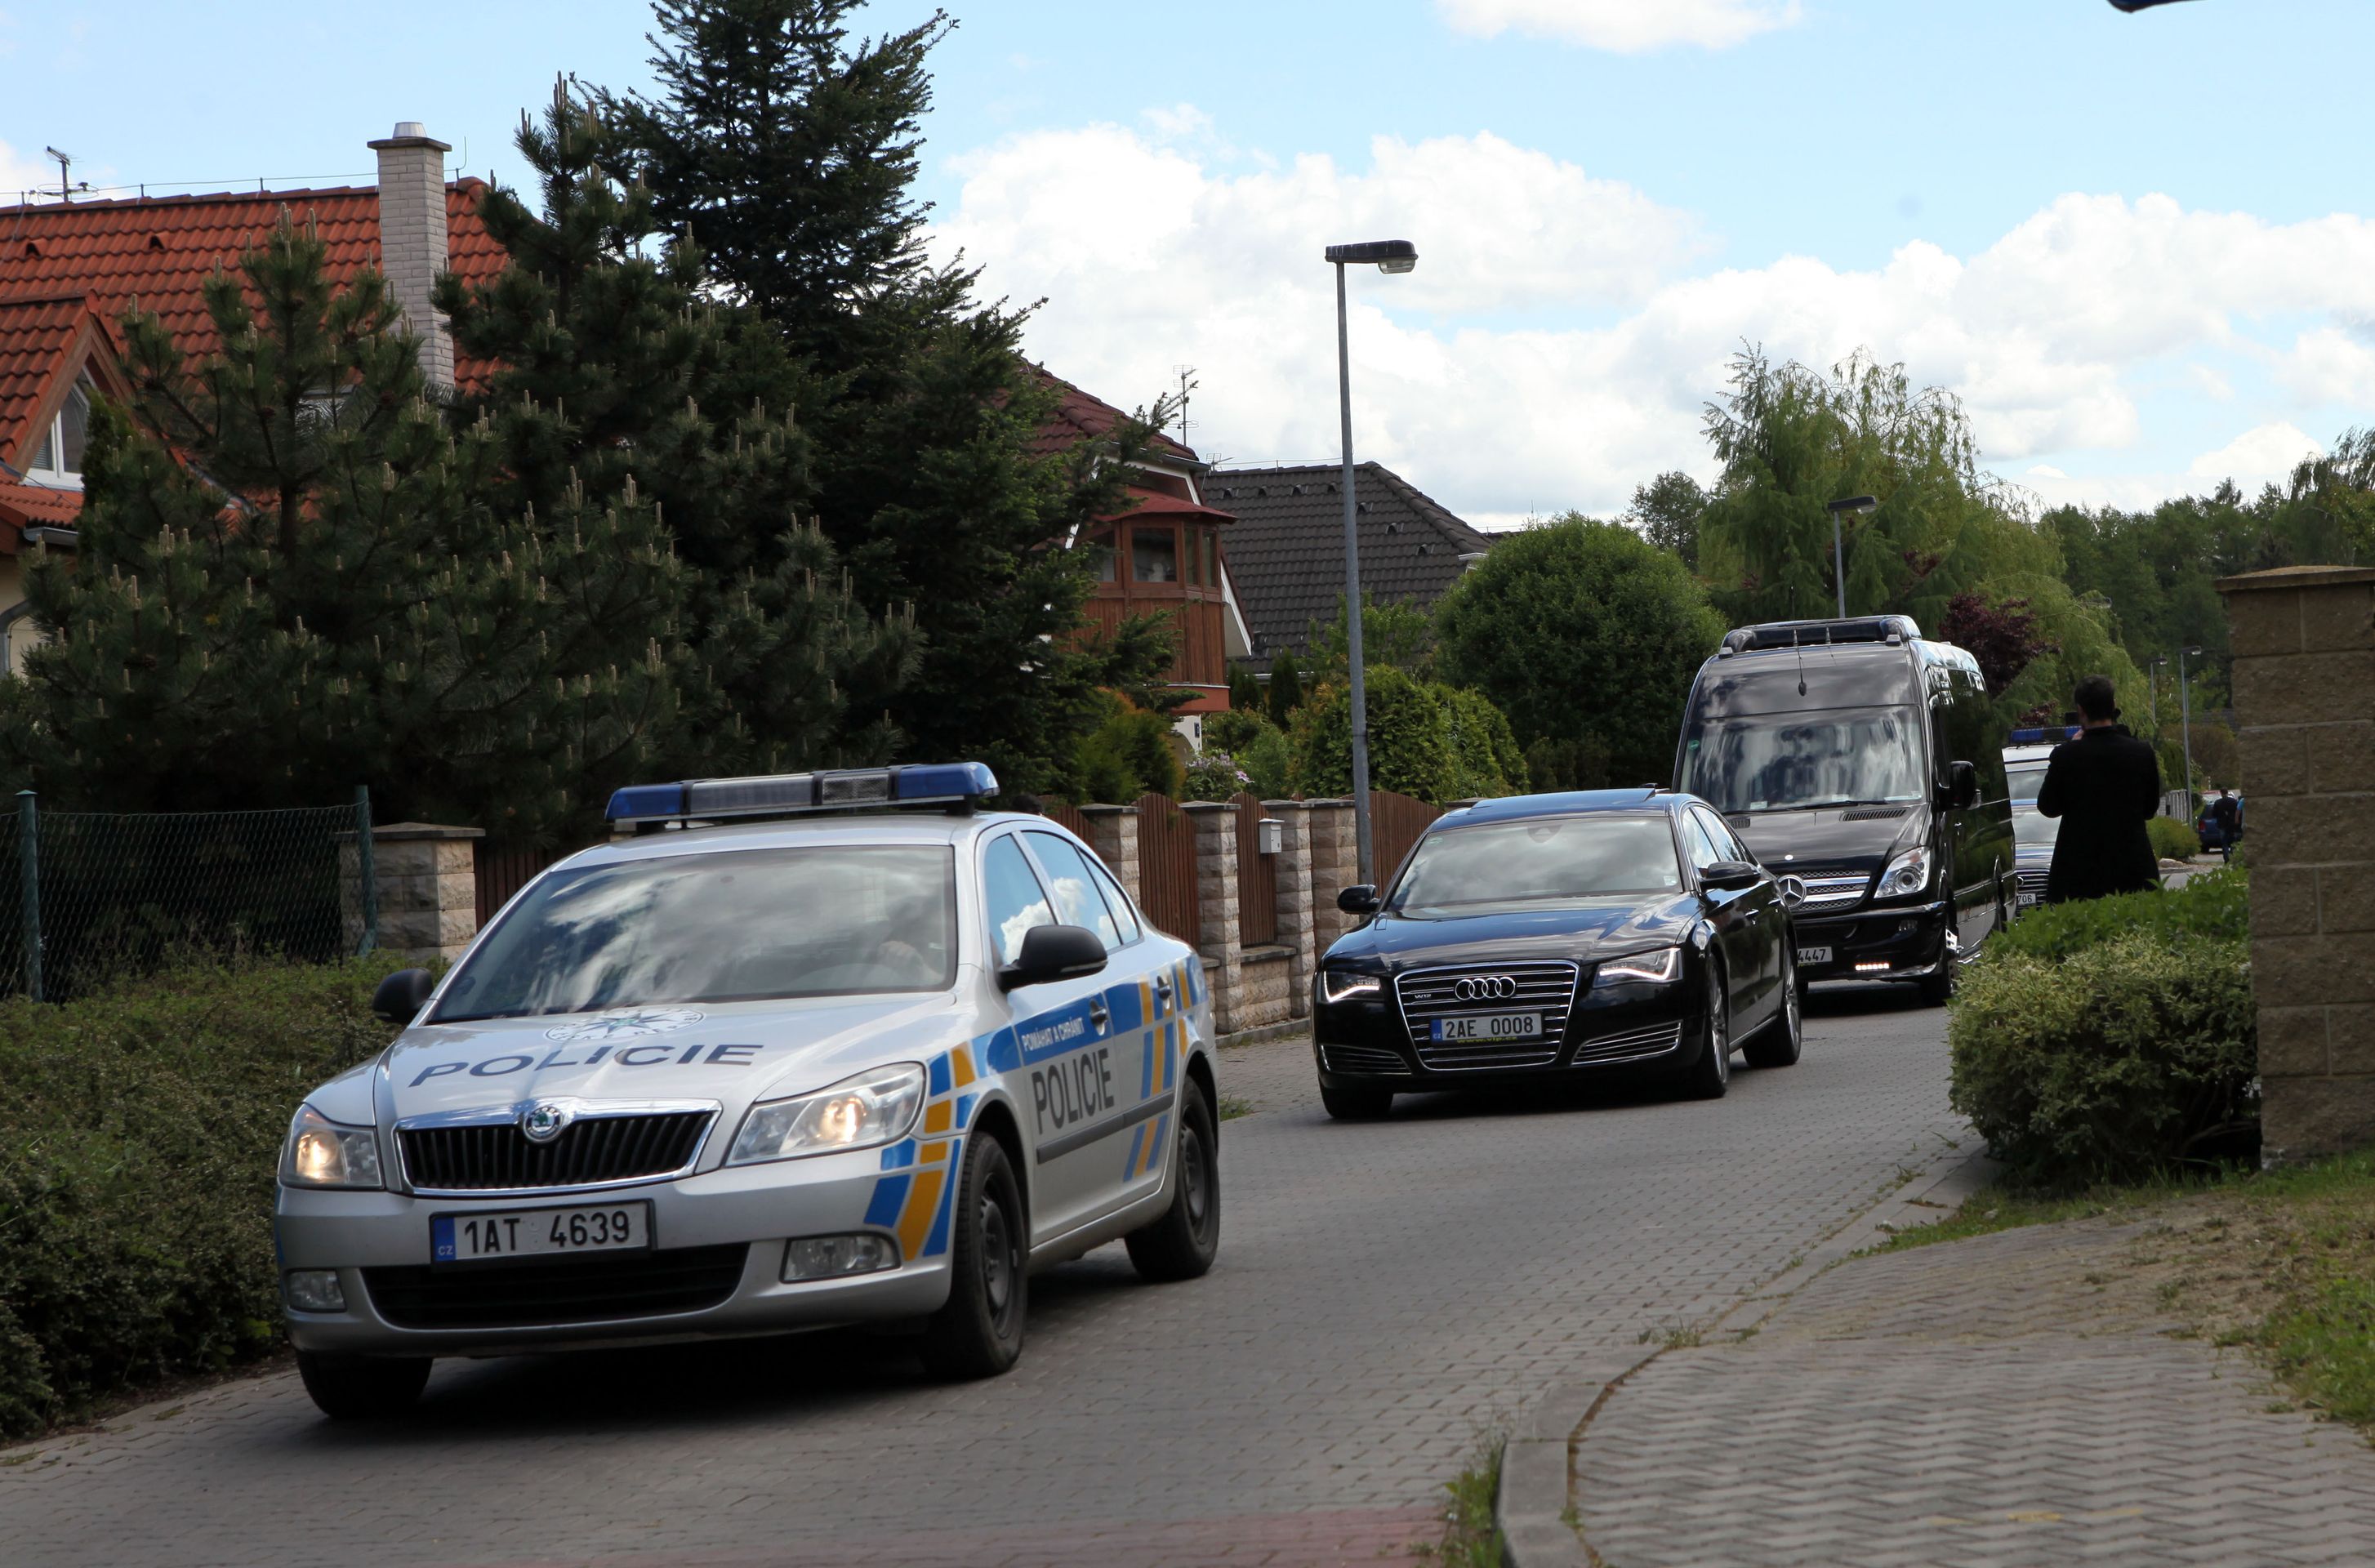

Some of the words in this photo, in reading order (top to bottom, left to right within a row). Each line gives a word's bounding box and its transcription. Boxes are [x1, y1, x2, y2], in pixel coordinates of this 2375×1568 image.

[1798, 948, 1826, 962] 4447
[1446, 1019, 1477, 1039] 2AE
[1491, 1016, 1534, 1036] 0008
[408, 1044, 764, 1088] POLICIE
[1032, 1048, 1115, 1135] POLICIE
[465, 1218, 520, 1254] 1AT
[550, 1210, 630, 1248] 4639
[438, 1245, 454, 1256] CZ
